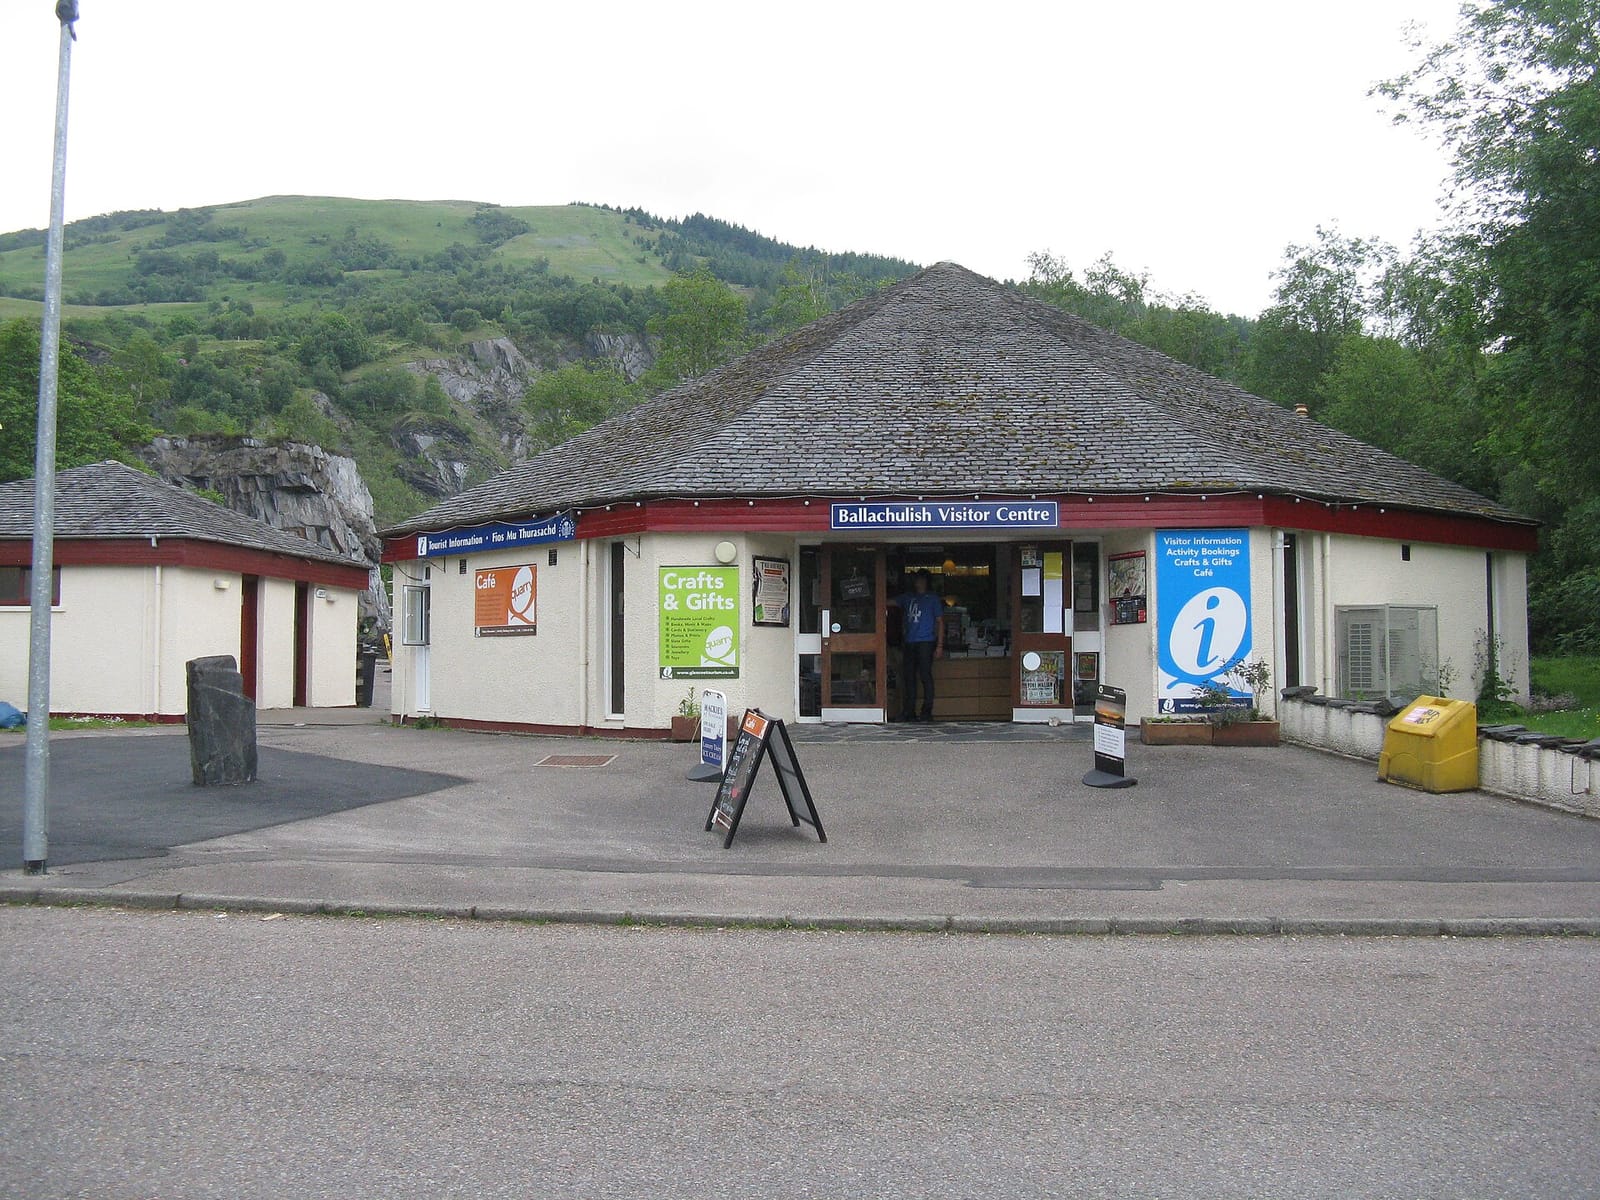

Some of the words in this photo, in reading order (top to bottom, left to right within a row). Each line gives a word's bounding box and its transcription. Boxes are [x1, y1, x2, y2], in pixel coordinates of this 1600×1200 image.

[838, 507, 932, 523] Ballachulish
[938, 507, 990, 522] Visitor
[996, 506, 1050, 521] Centre
[429, 539, 448, 551] Tourist
[448, 535, 483, 549] Information
[491, 532, 505, 544] Fios
[506, 531, 517, 542] Mu
[518, 524, 557, 540] Thurasachd
[1163, 537, 1191, 545] Visitor
[1193, 537, 1242, 545] Information
[1166, 548, 1199, 557] Activity
[1201, 548, 1240, 557] Bookings
[1174, 558, 1200, 566] Crafts
[1202, 558, 1209, 566] &
[1211, 558, 1232, 566] Gifts
[476, 573, 496, 589] Café
[663, 572, 724, 590] Crafts
[1193, 569, 1214, 577] Café
[663, 593, 679, 610] &
[686, 593, 735, 610] Gifts
